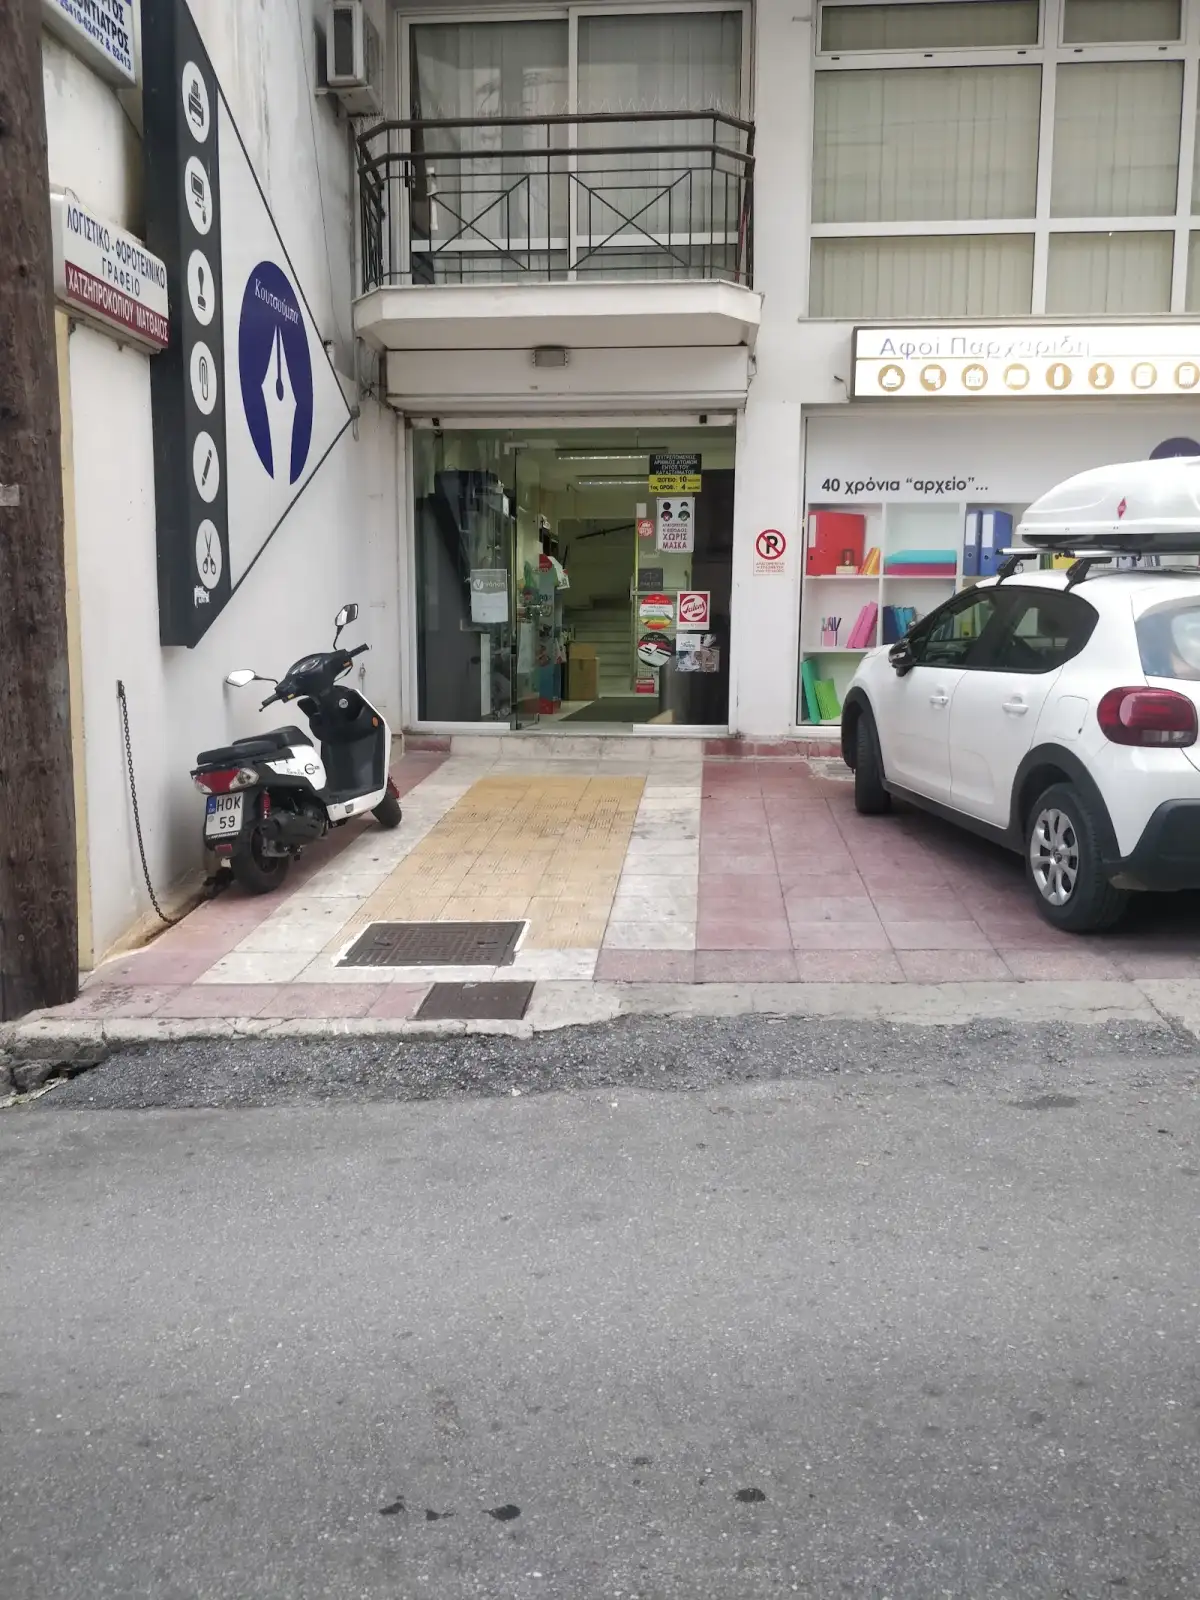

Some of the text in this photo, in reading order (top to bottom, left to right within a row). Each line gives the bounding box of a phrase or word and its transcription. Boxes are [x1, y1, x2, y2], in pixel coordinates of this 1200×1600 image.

[67, 204, 110, 253] ΛΟΓΙΣΤΙΚΟ
[116, 236, 165, 290] ΦΟΡΟΤΕΧΝΙΚΟ
[102, 257, 141, 297] ΓΡΑΦΕΙΟ
[67, 266, 134, 324] ΧΑΤΖΗΠΡΟΚΟΠΙΟΥ
[821, 478, 841, 492] 40
[844, 476, 901, 494] χρόνια
[662, 541, 687, 549] ΜΑΣΚΑ
[219, 815, 236, 829] 59
